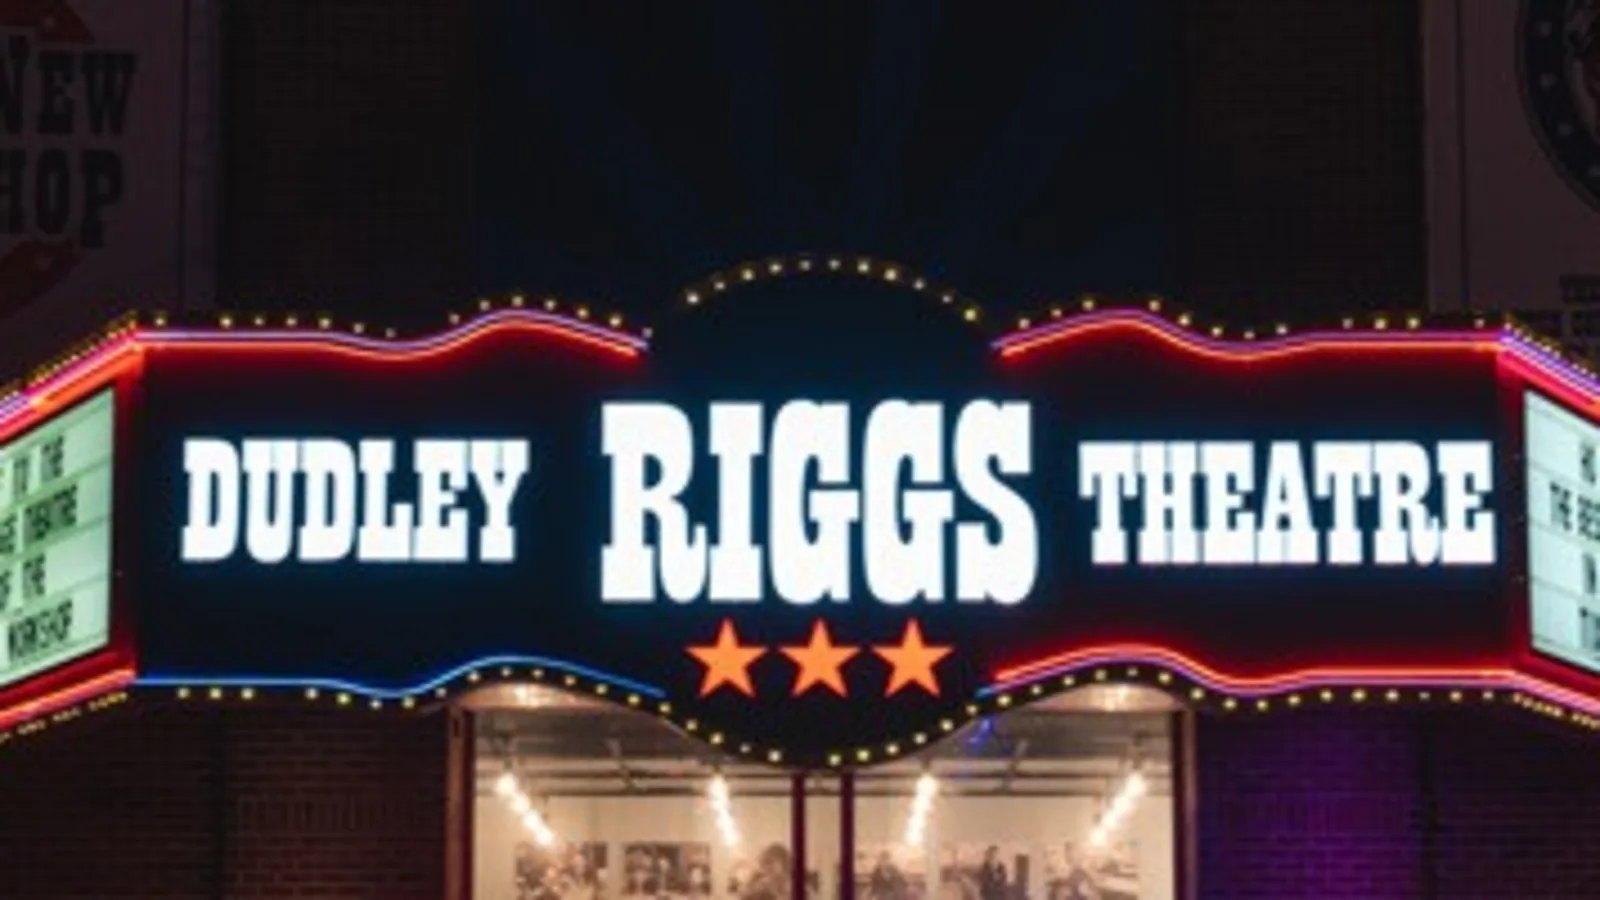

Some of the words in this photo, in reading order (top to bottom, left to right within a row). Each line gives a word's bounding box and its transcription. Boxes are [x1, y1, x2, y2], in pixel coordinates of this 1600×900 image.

[181, 438, 529, 563] DUDLEY
[599, 398, 1039, 605] RIGGS
[1077, 440, 1495, 565] THEATRE
